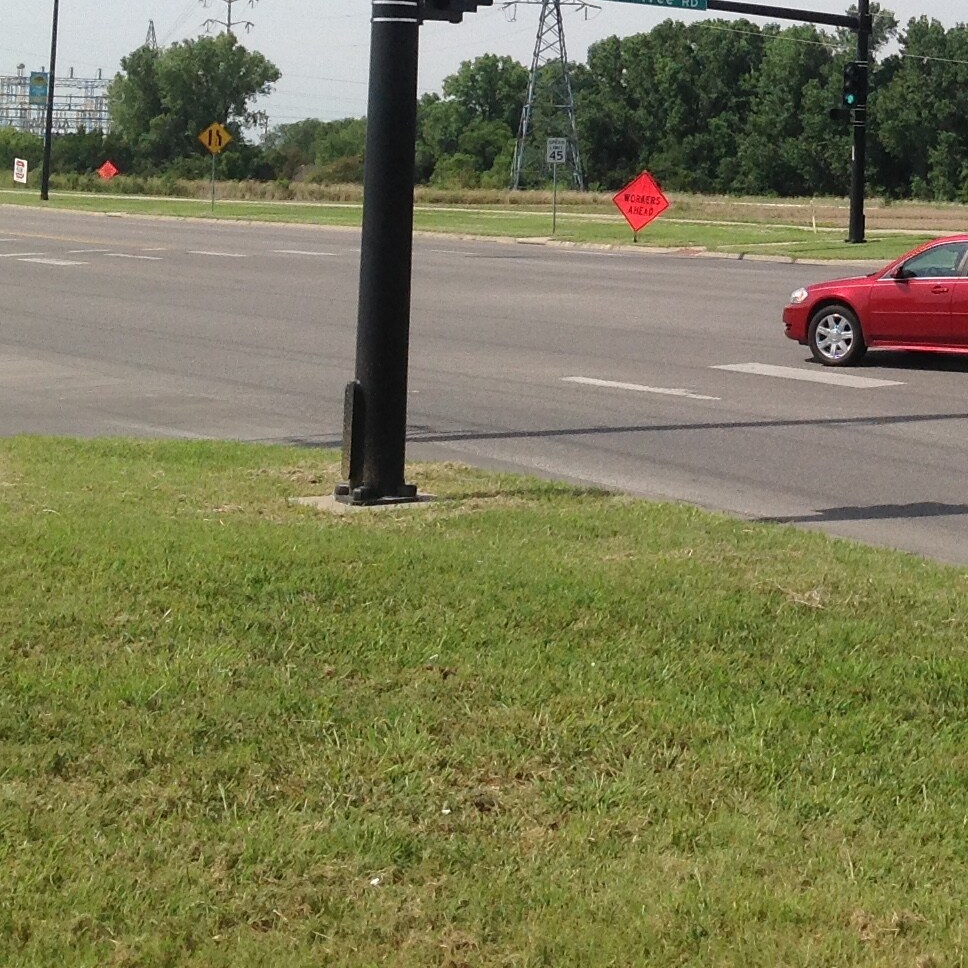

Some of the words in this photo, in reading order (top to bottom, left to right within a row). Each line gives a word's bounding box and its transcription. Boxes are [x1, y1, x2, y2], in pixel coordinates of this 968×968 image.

[549, 150, 564, 161] 45
[623, 194, 661, 206] WORKERS
[628, 206, 654, 217] AHEAD
